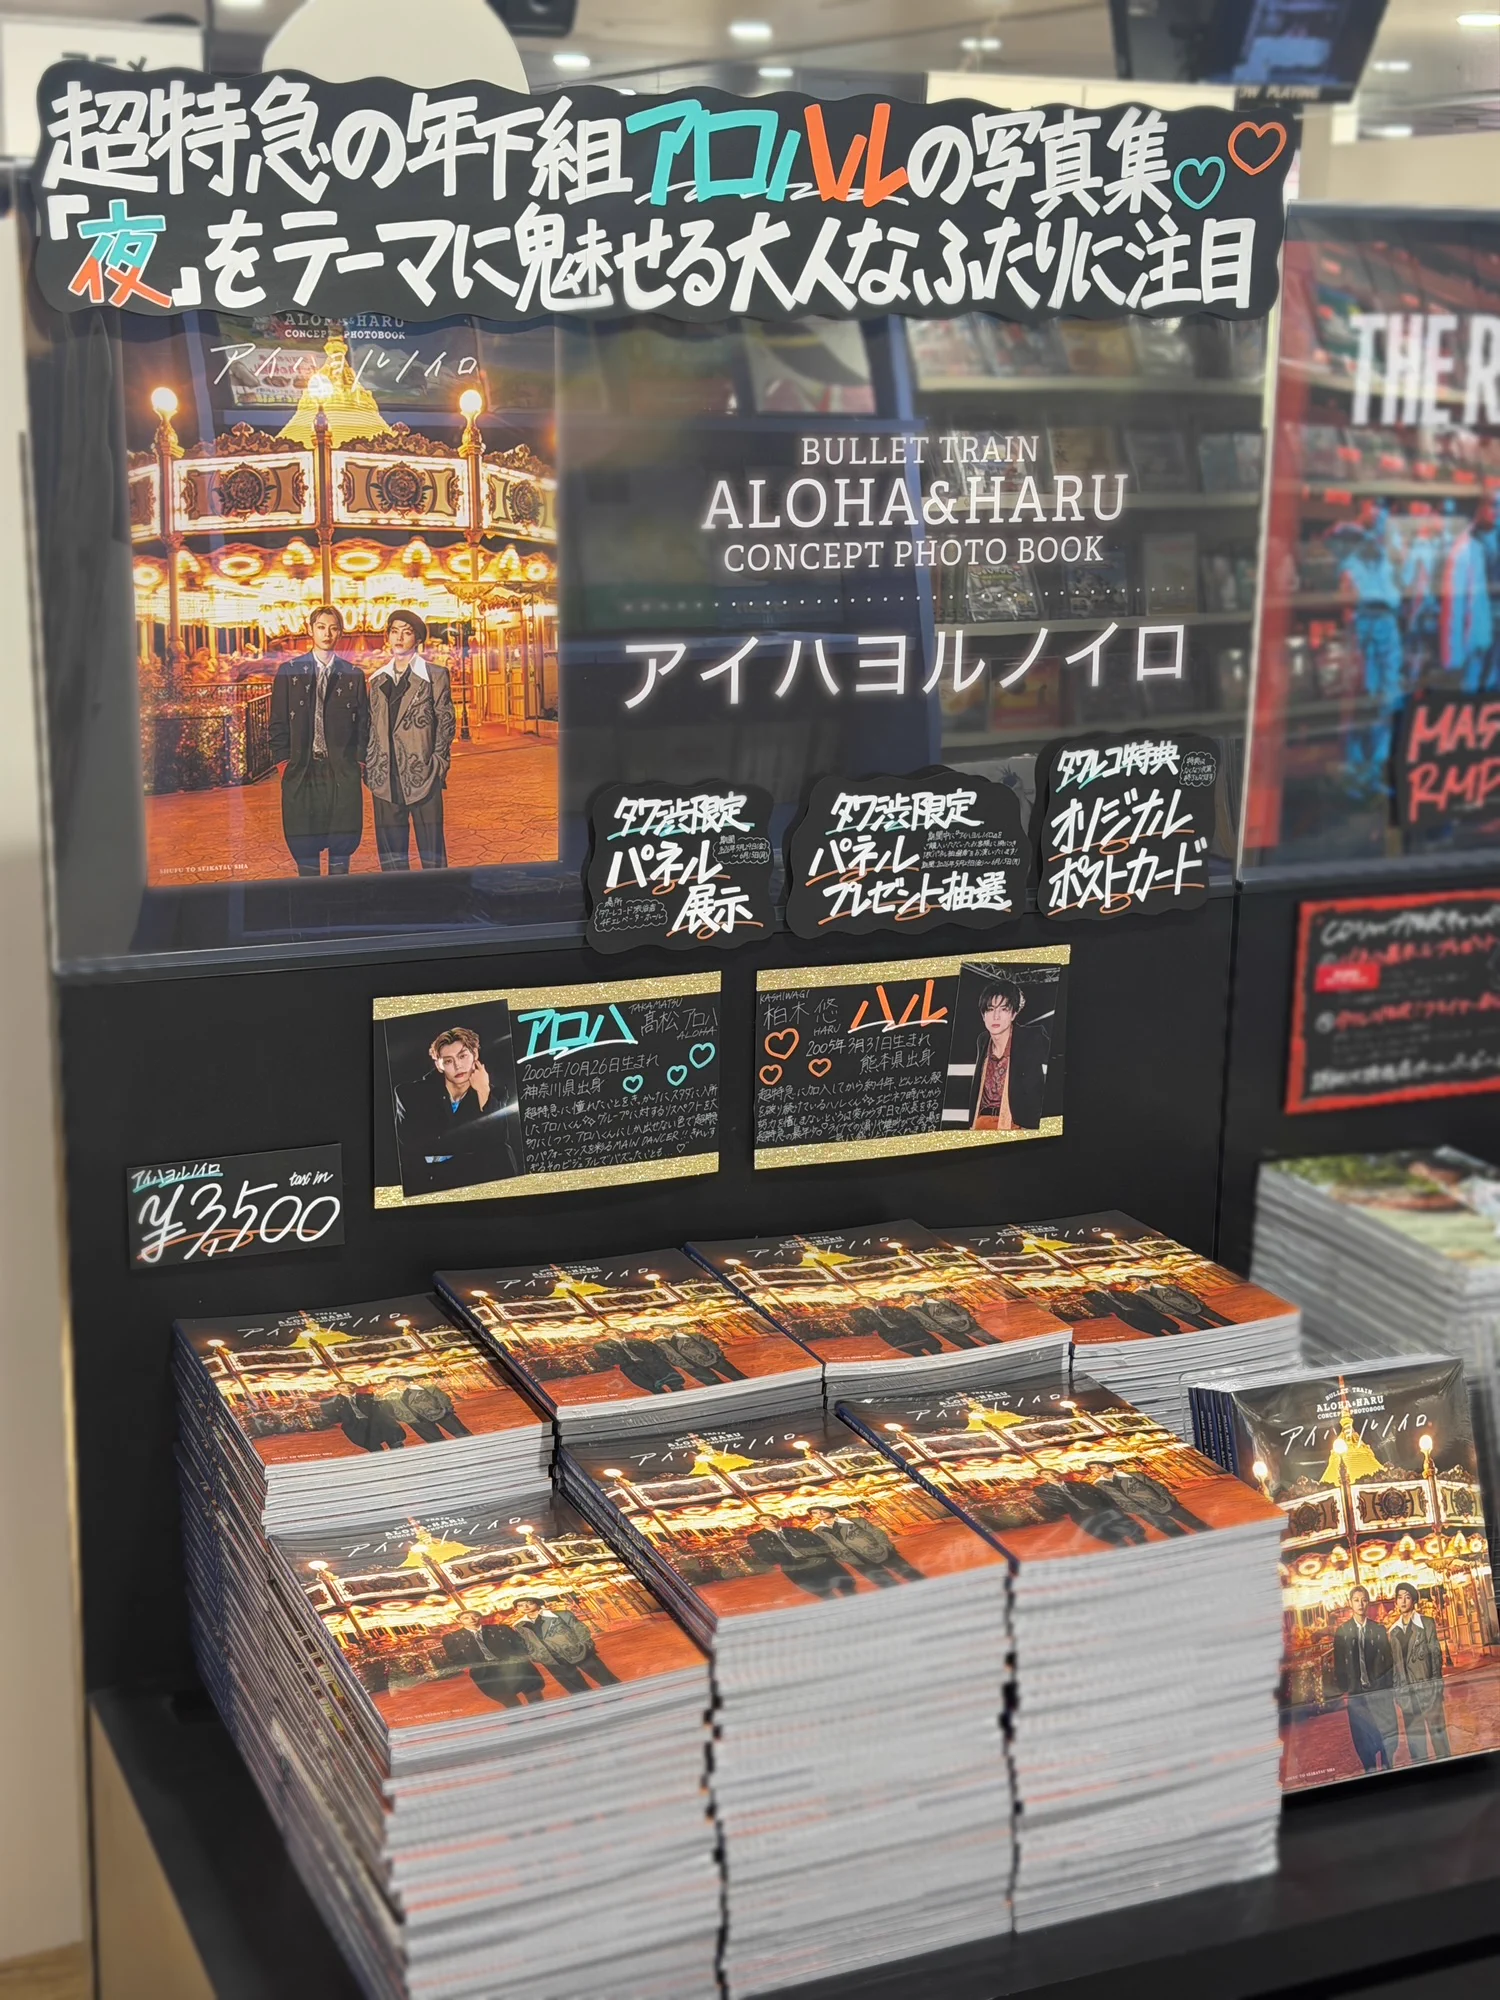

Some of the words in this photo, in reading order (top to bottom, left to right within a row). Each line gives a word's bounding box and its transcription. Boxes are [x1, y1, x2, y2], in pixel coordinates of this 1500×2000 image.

[41, 76, 1172, 218] 超特急の年下組アロハルの写真集
[46, 195, 1256, 312] 「夜」をテーマに魅せる大人なふたりに注目
[344, 330, 406, 340] PHOTOBOOK
[1349, 313, 1457, 425] THE
[801, 437, 929, 466] BULLET
[939, 435, 1040, 464] TRAIN
[701, 472, 1128, 530] ALOHA&HARU
[724, 541, 884, 573] CONCEPT
[896, 538, 1009, 568] PHOTO
[1018, 535, 1104, 564] BOOK
[624, 622, 1186, 710] アイハヨルノイロ
[1051, 788, 1193, 854] オリジナル
[606, 839, 723, 888] パネル
[808, 835, 920, 876] パネル
[1049, 837, 1207, 909] ポストカード
[672, 883, 753, 934] 展示
[822, 870, 1012, 918] プレゼント抽選
[628, 998, 683, 1013] TAKAMATSU
[759, 989, 810, 1004] KASHIWAGI
[850, 979, 948, 1028] ハル
[518, 1004, 635, 1057] アロハ
[677, 1027, 717, 1040] ALOHA
[806, 1033, 932, 1058] 2005年3月31日生まれ
[813, 1024, 841, 1037] HARU
[522, 1053, 660, 1082] 2000年10月26日生まれ
[859, 1048, 936, 1076] 熊本県出身
[520, 1076, 609, 1100] 神奈川県出身
[289, 1171, 312, 1187] tax
[138, 1180, 341, 1263] ¥3,500
[1316, 1395, 1384, 1412] ALOHA&HARU
[1352, 1387, 1373, 1395] TRAIN
